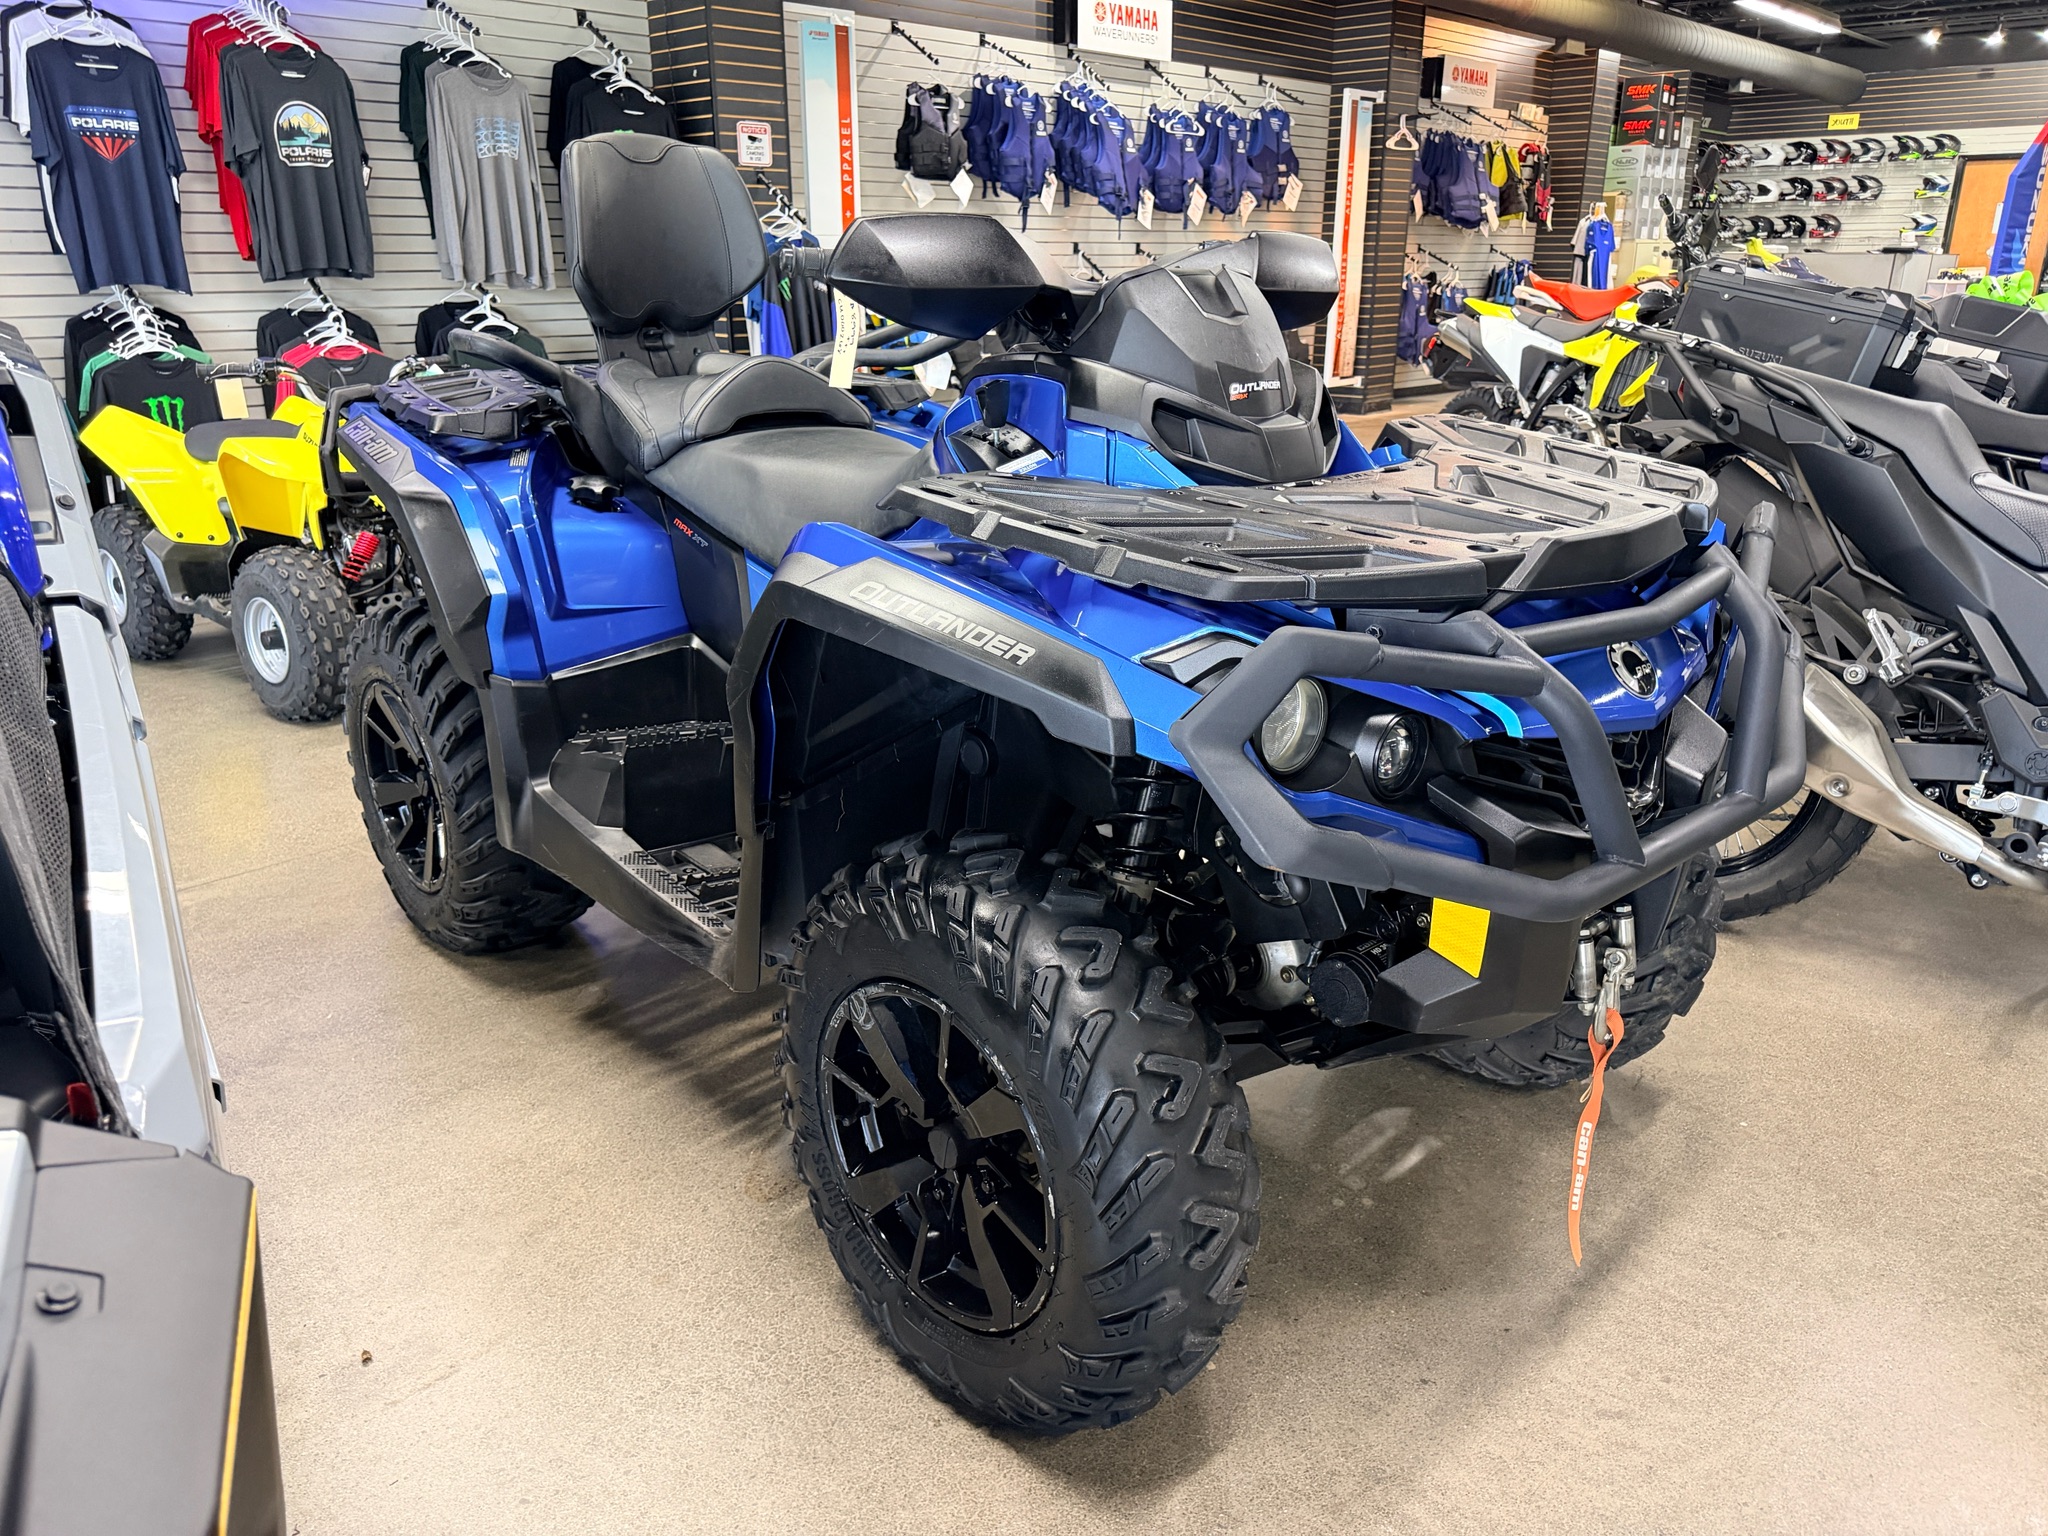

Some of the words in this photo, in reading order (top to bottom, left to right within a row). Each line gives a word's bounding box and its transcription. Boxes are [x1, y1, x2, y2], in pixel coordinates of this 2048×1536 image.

[1109, 2, 1158, 31] YAMAHA
[1460, 66, 1488, 87] YAMAHA
[1627, 84, 1657, 95] SMK
[71, 116, 139, 131] POLARIS
[1623, 120, 1653, 130] SMK
[281, 147, 333, 158] POLARIS
[841, 117, 853, 195] APPAREL
[1738, 346, 1784, 364] SUZUKI
[1229, 380, 1281, 395] OUTLANDER
[673, 517, 694, 538] MAX
[849, 581, 1036, 666] OUTLANDER
[1571, 1121, 1593, 1211] can-am
